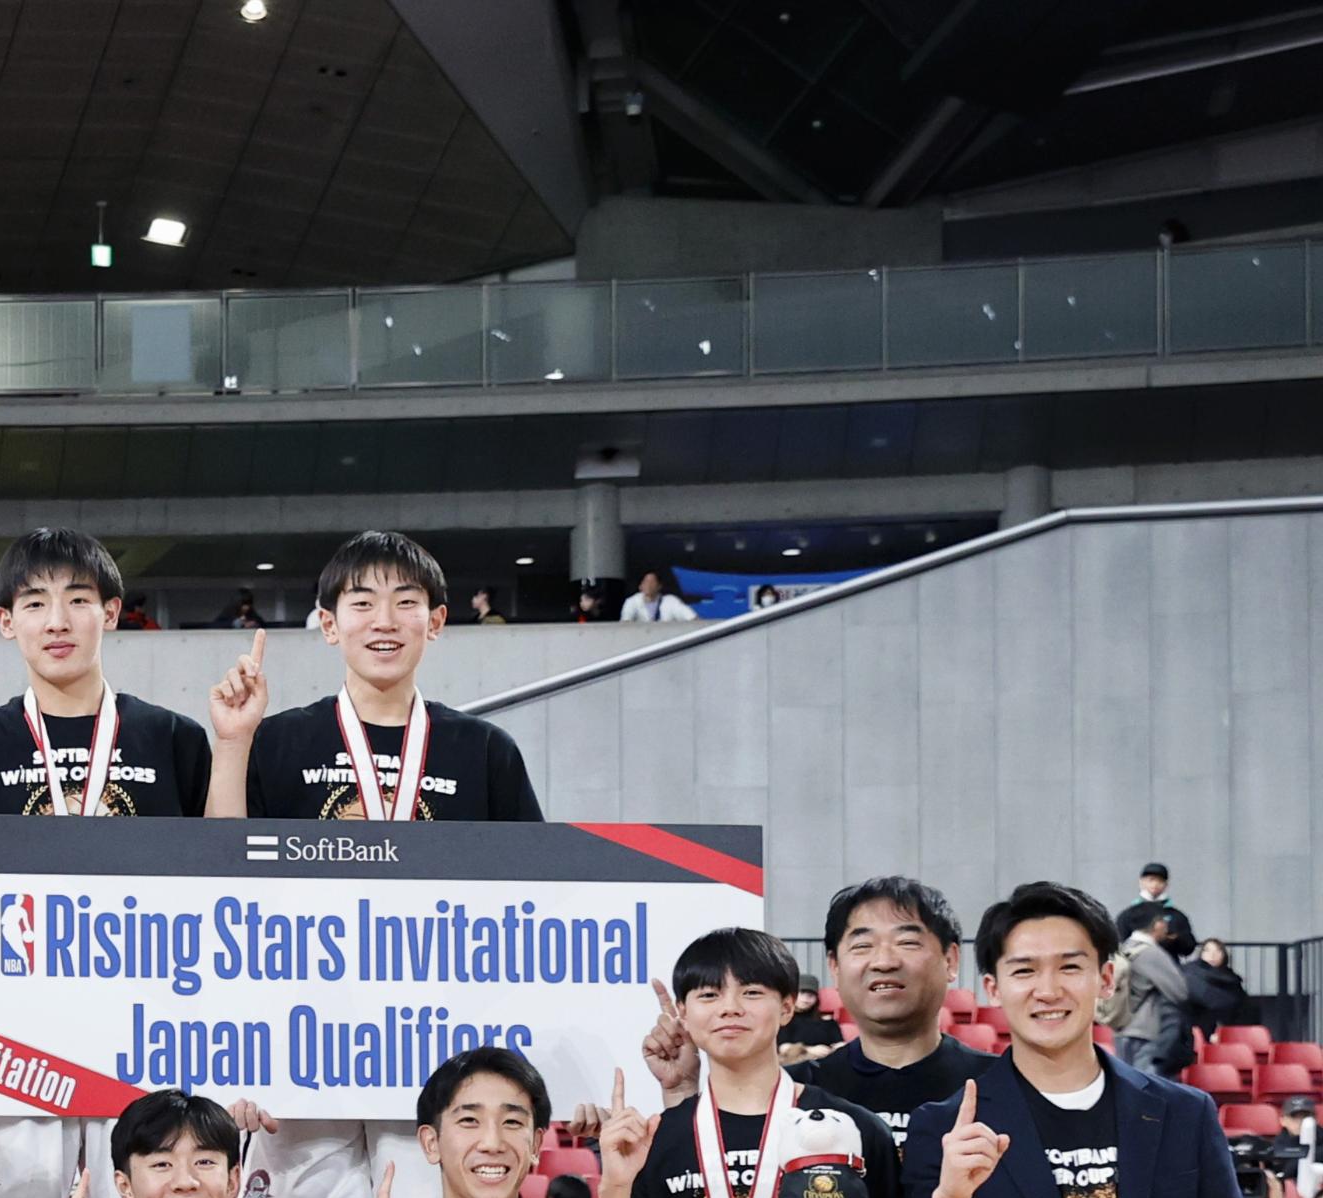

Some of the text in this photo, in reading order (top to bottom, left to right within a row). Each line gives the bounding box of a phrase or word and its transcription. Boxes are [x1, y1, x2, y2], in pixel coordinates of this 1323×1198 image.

[0, 765, 67, 786] WINTR
[109, 766, 156, 783] 2025
[420, 776, 457, 795] 025
[286, 836, 399, 864] SoftBank
[46, 894, 647, 995] Rising Stars Invitational
[4, 958, 22, 973] NBA
[117, 1003, 271, 1094] Japan
